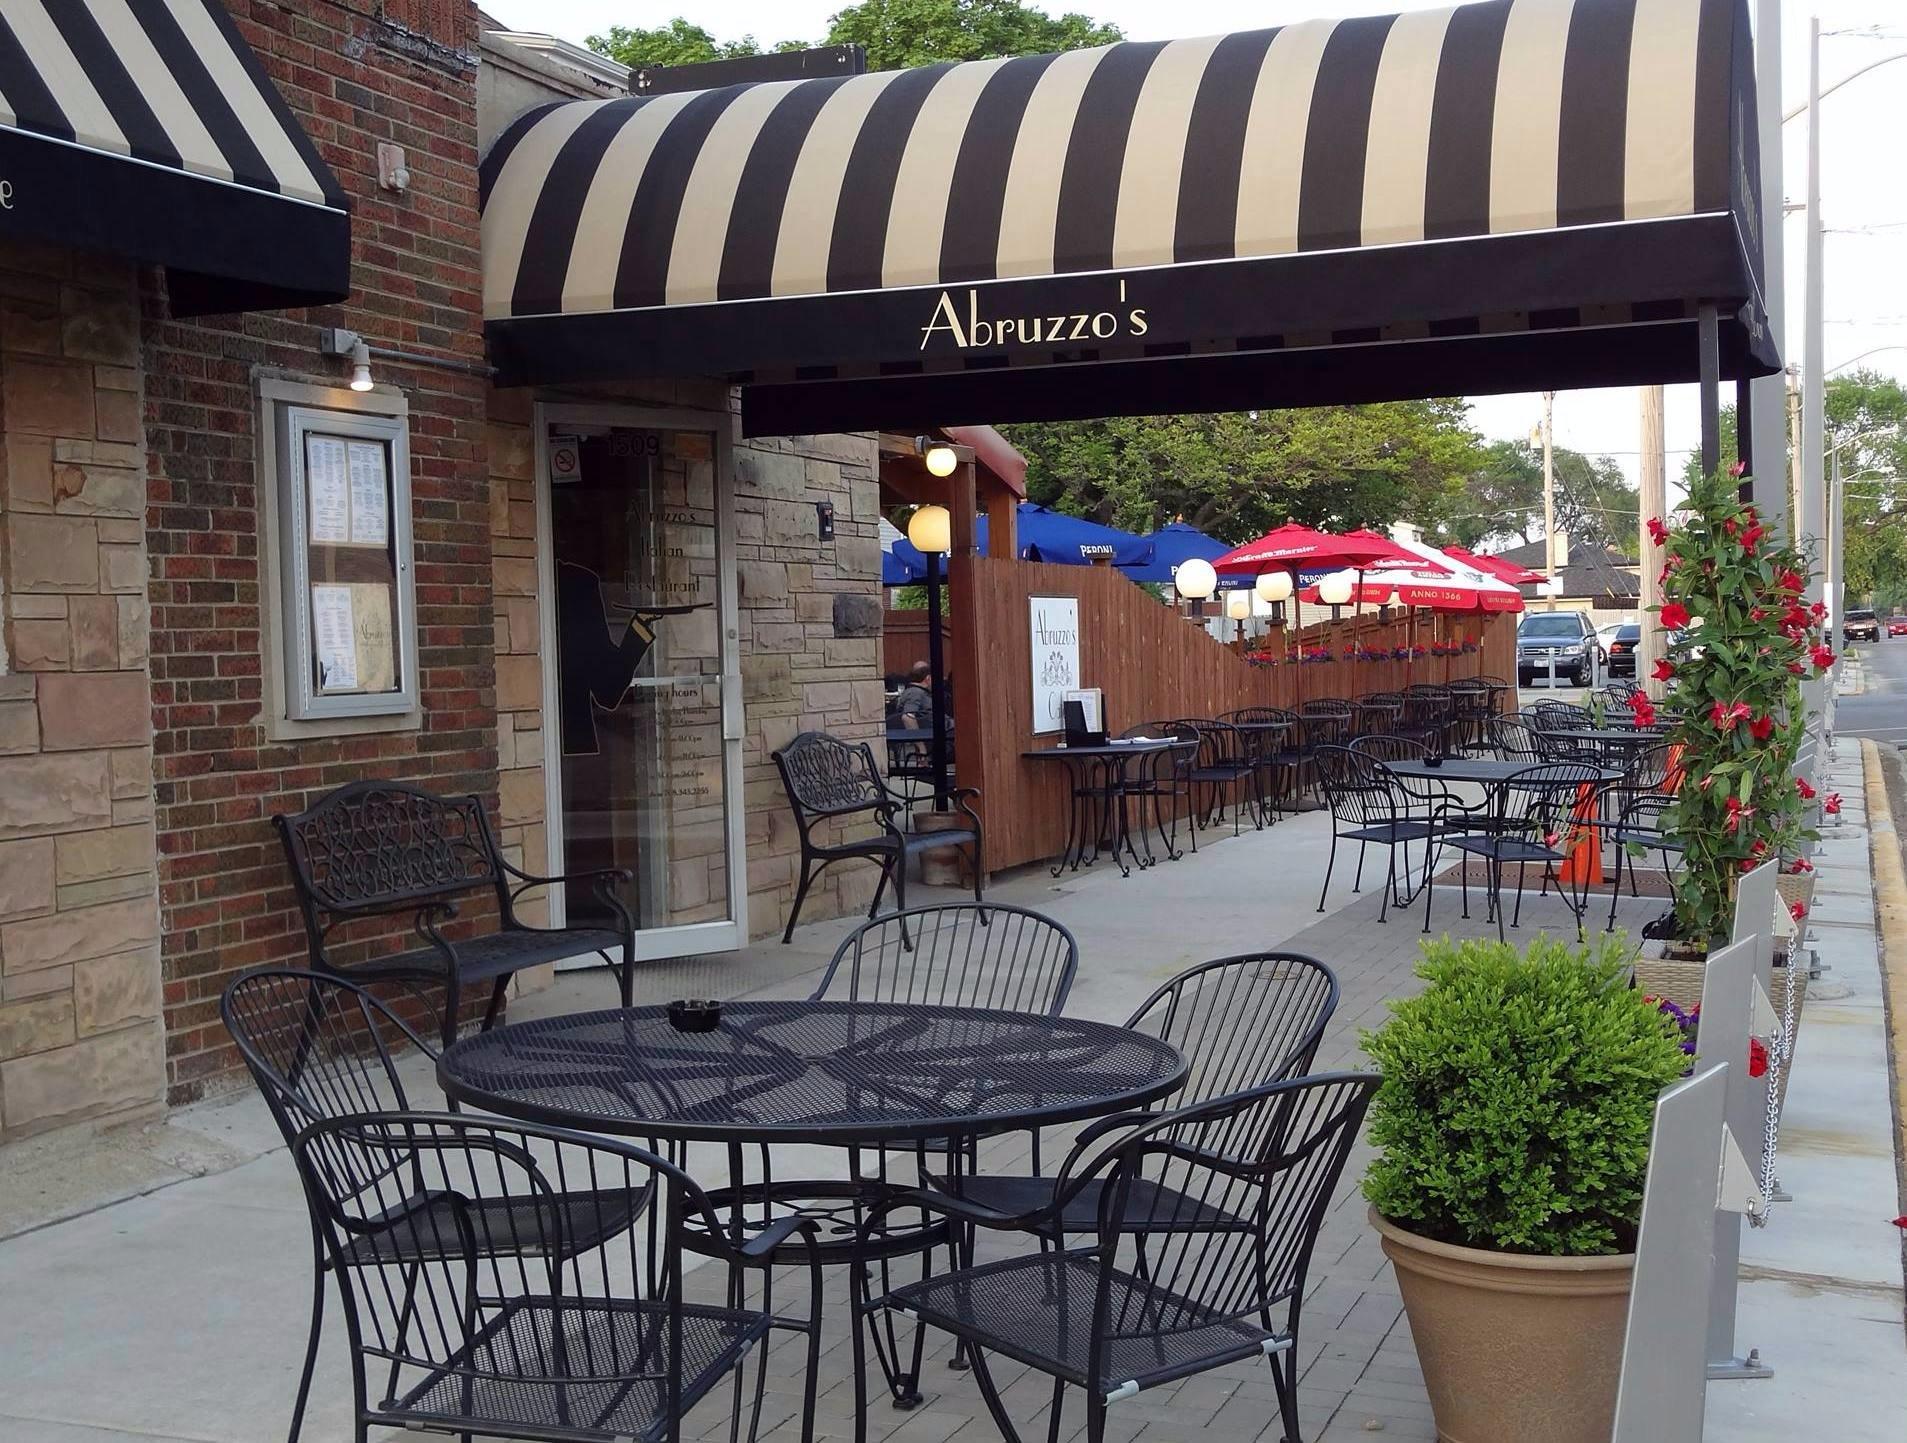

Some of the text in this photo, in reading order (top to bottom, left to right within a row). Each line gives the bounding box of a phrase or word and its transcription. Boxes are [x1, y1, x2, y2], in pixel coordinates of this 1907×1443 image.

[920, 278, 1149, 351] Abruzzo's
[607, 433, 660, 457] 1509
[1079, 544, 1113, 558] PERONI
[1410, 590, 1461, 601] ANNO 1366
[1035, 608, 1076, 646] Abruzzo's
[671, 682, 698, 697] hours
